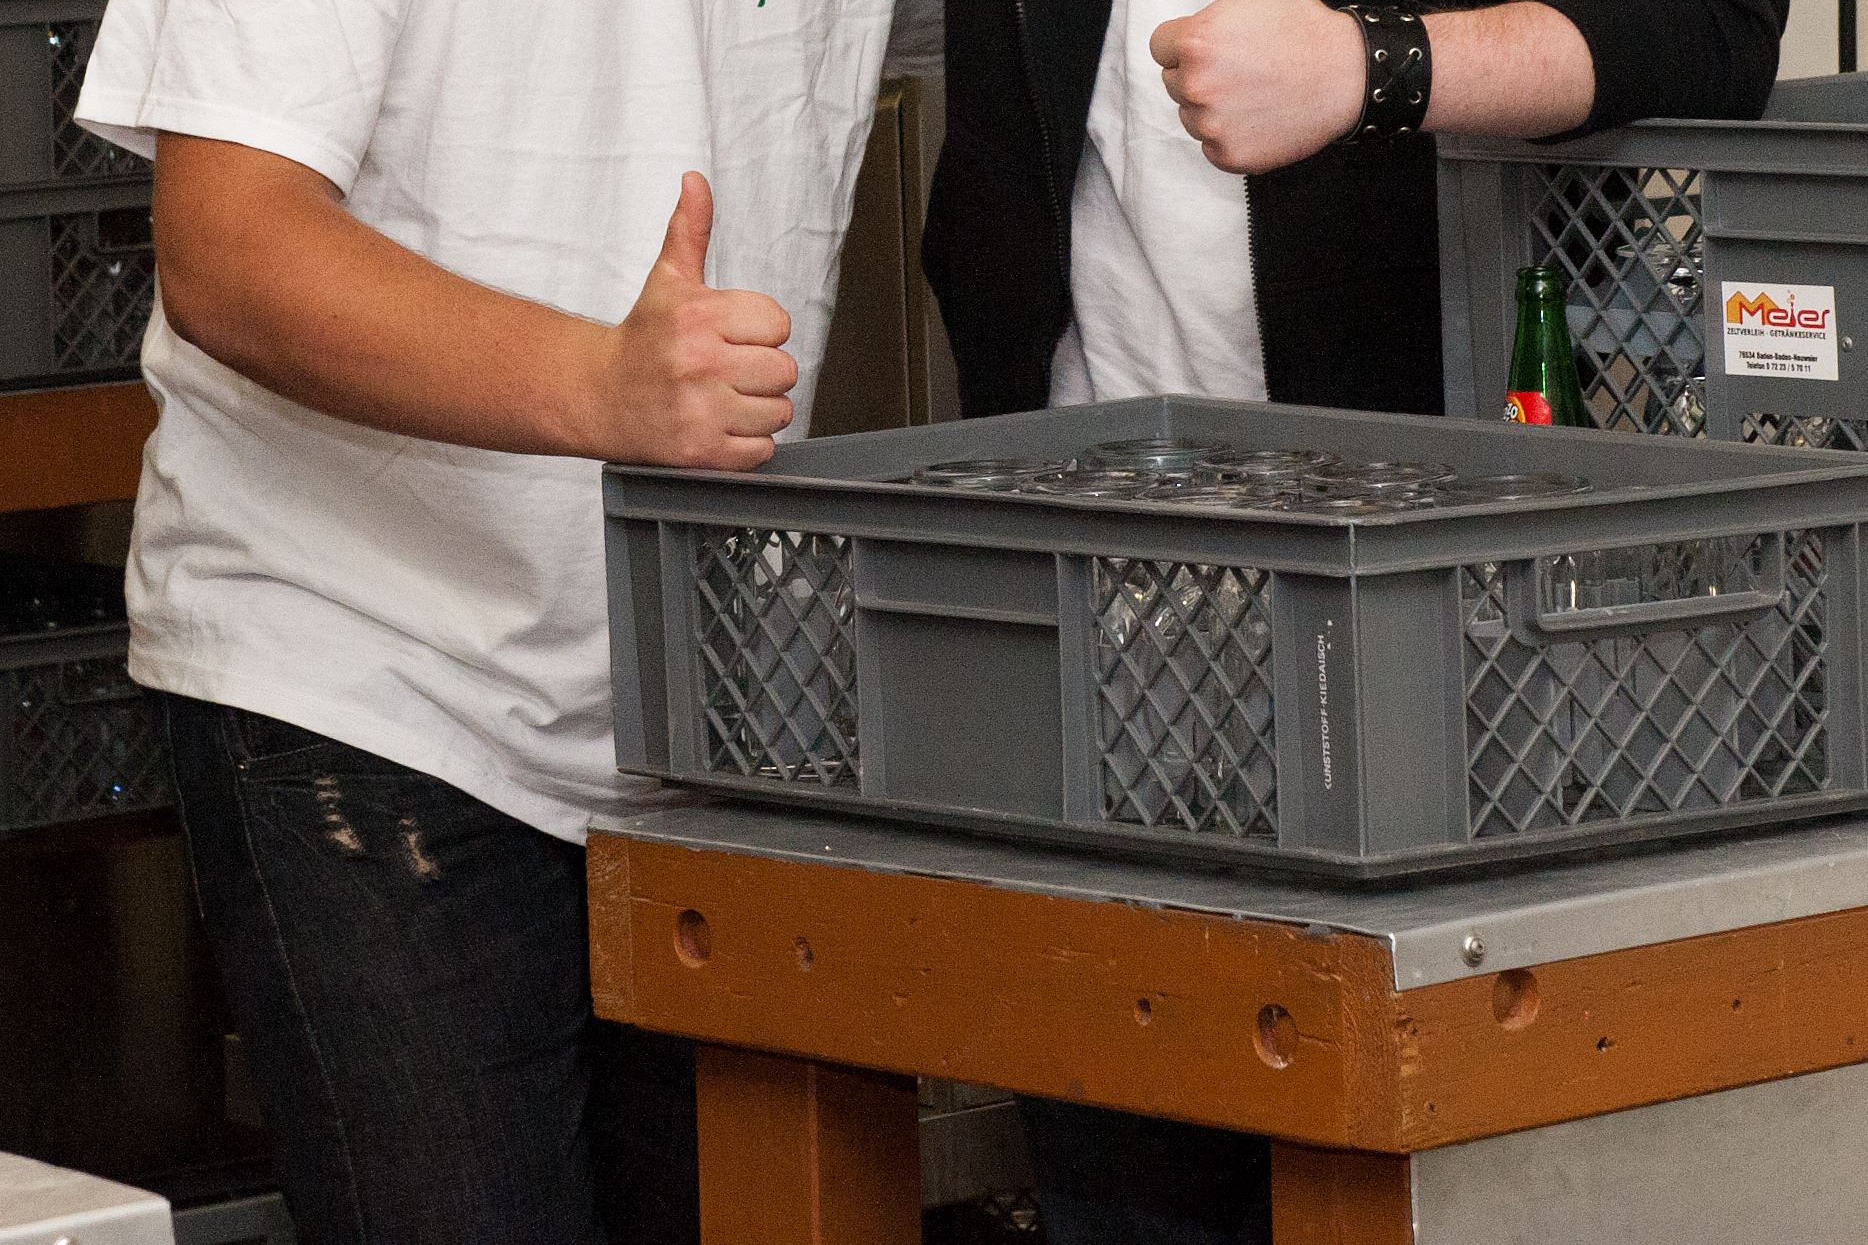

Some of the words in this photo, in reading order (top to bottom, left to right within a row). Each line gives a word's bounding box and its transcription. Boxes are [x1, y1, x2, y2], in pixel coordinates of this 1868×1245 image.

[1735, 294, 1830, 329] Meier
[1727, 327, 1765, 336] ZELTVERLEIH
[1770, 329, 1826, 340] GETRÄNKESERVICE
[1746, 361, 1765, 369] Telefon
